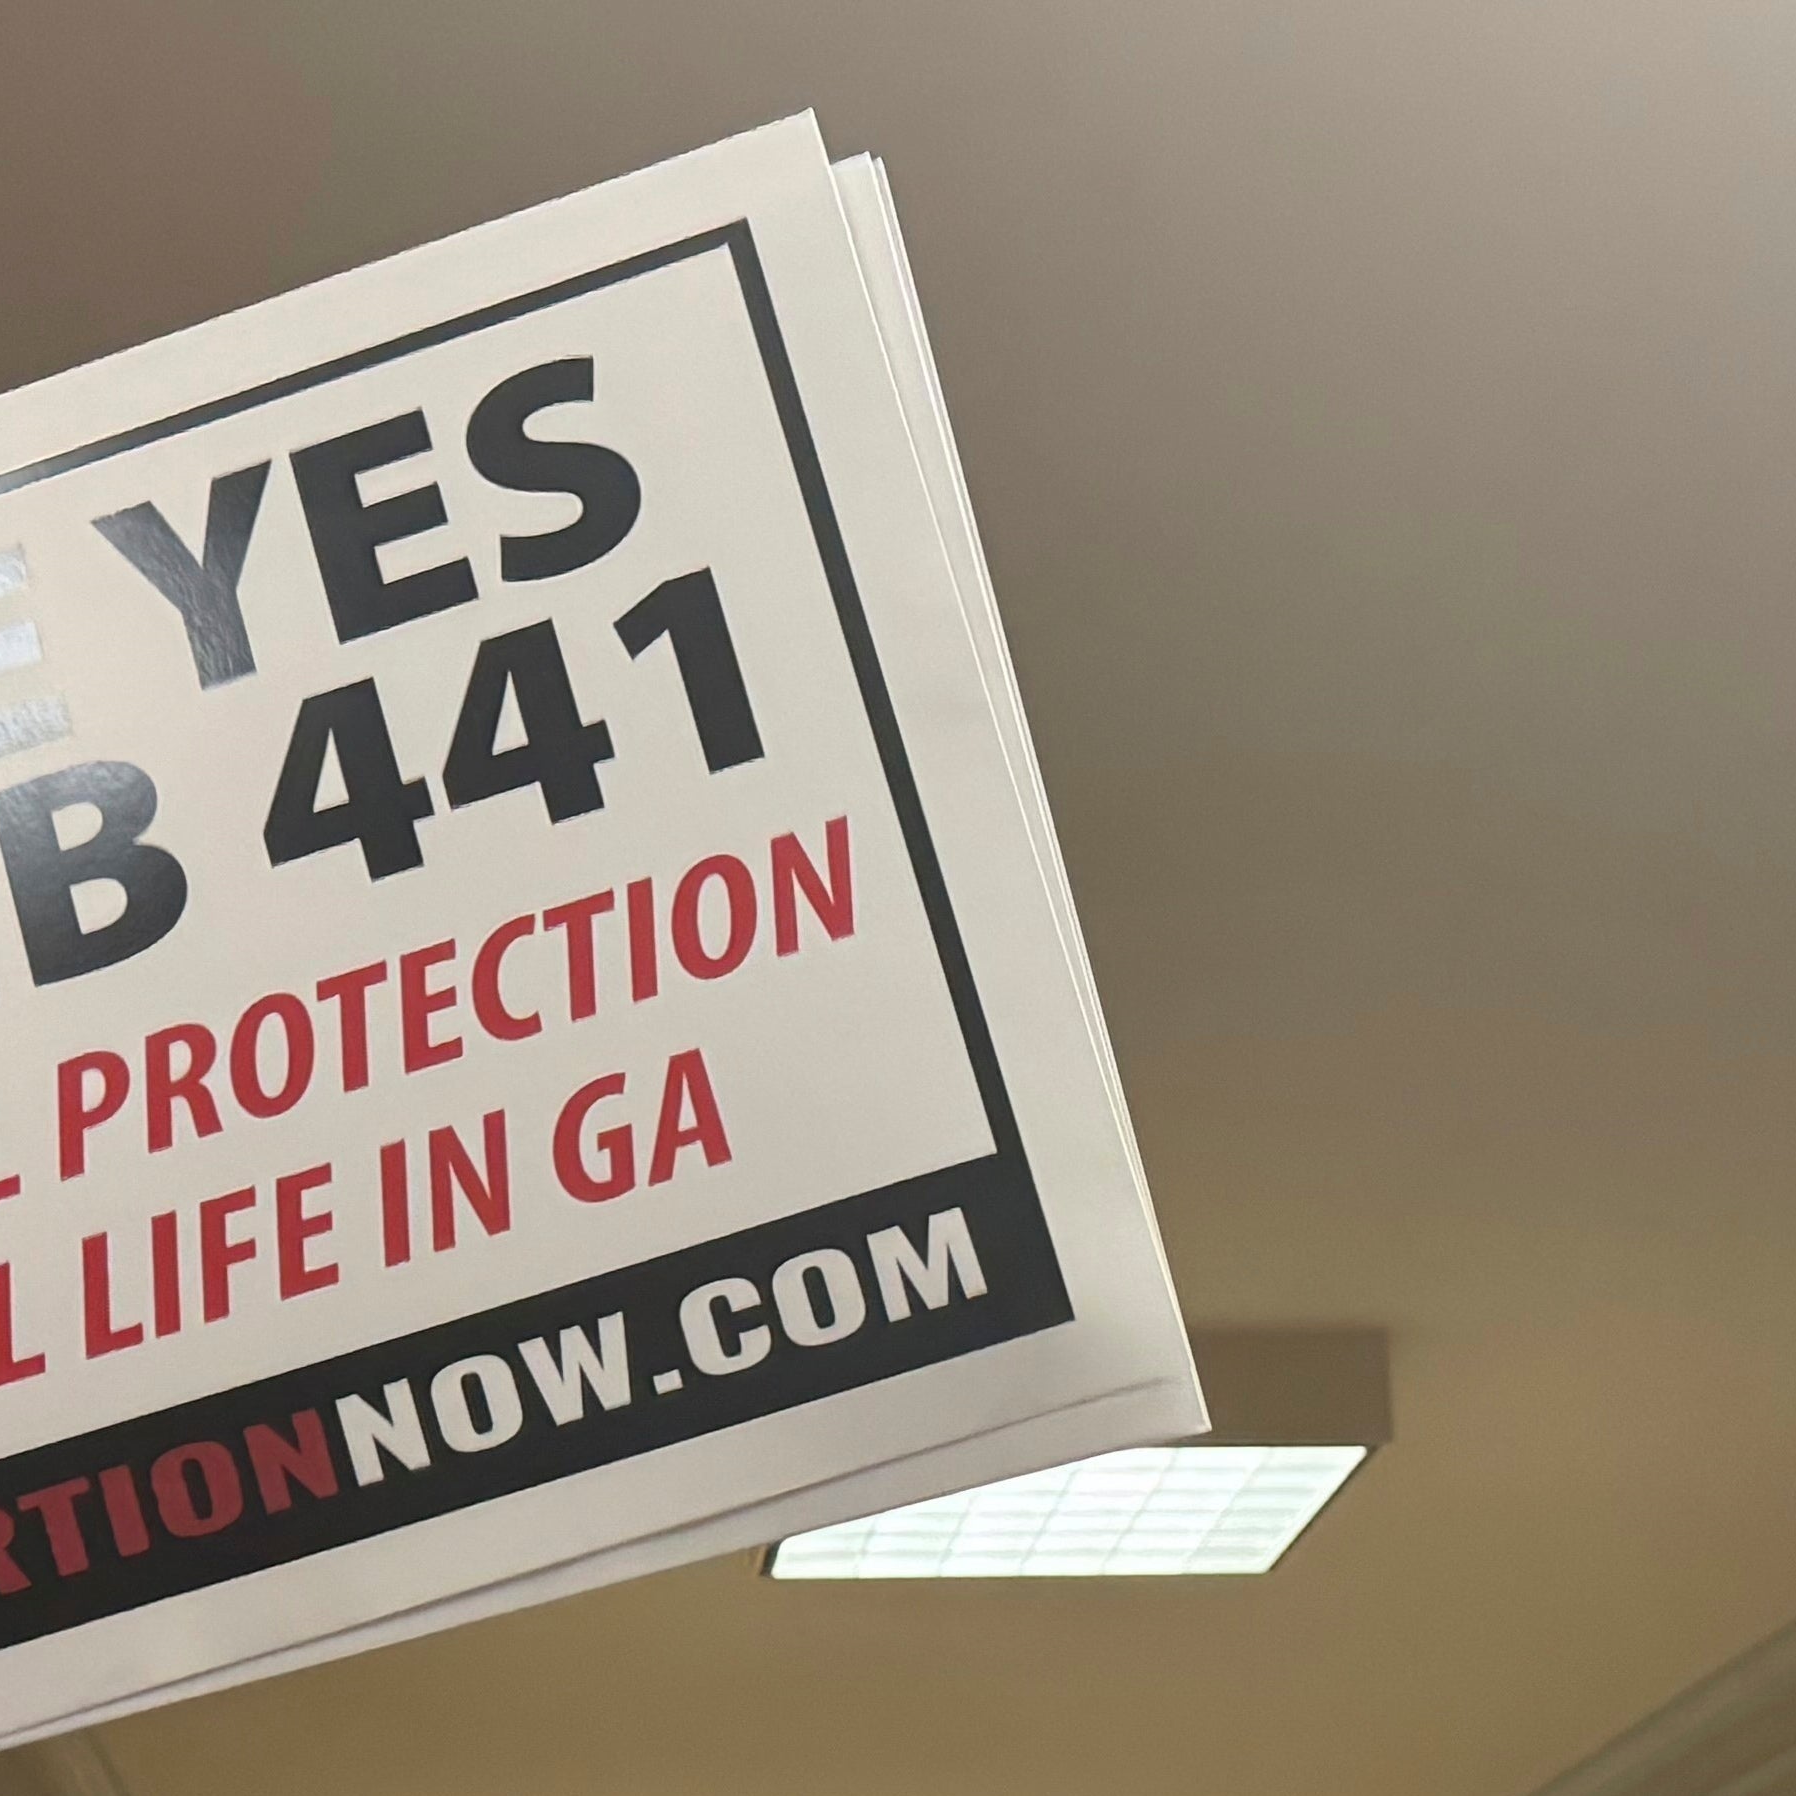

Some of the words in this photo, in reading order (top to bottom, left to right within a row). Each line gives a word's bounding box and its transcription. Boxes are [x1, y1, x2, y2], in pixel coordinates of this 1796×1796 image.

[91, 355, 641, 690] YES
[263, 570, 766, 883] 441
[55, 817, 858, 1180] PROTECTION
[81, 1172, 336, 1358] LIFE
[380, 1111, 512, 1266] IN
[553, 1047, 734, 1203] GA
